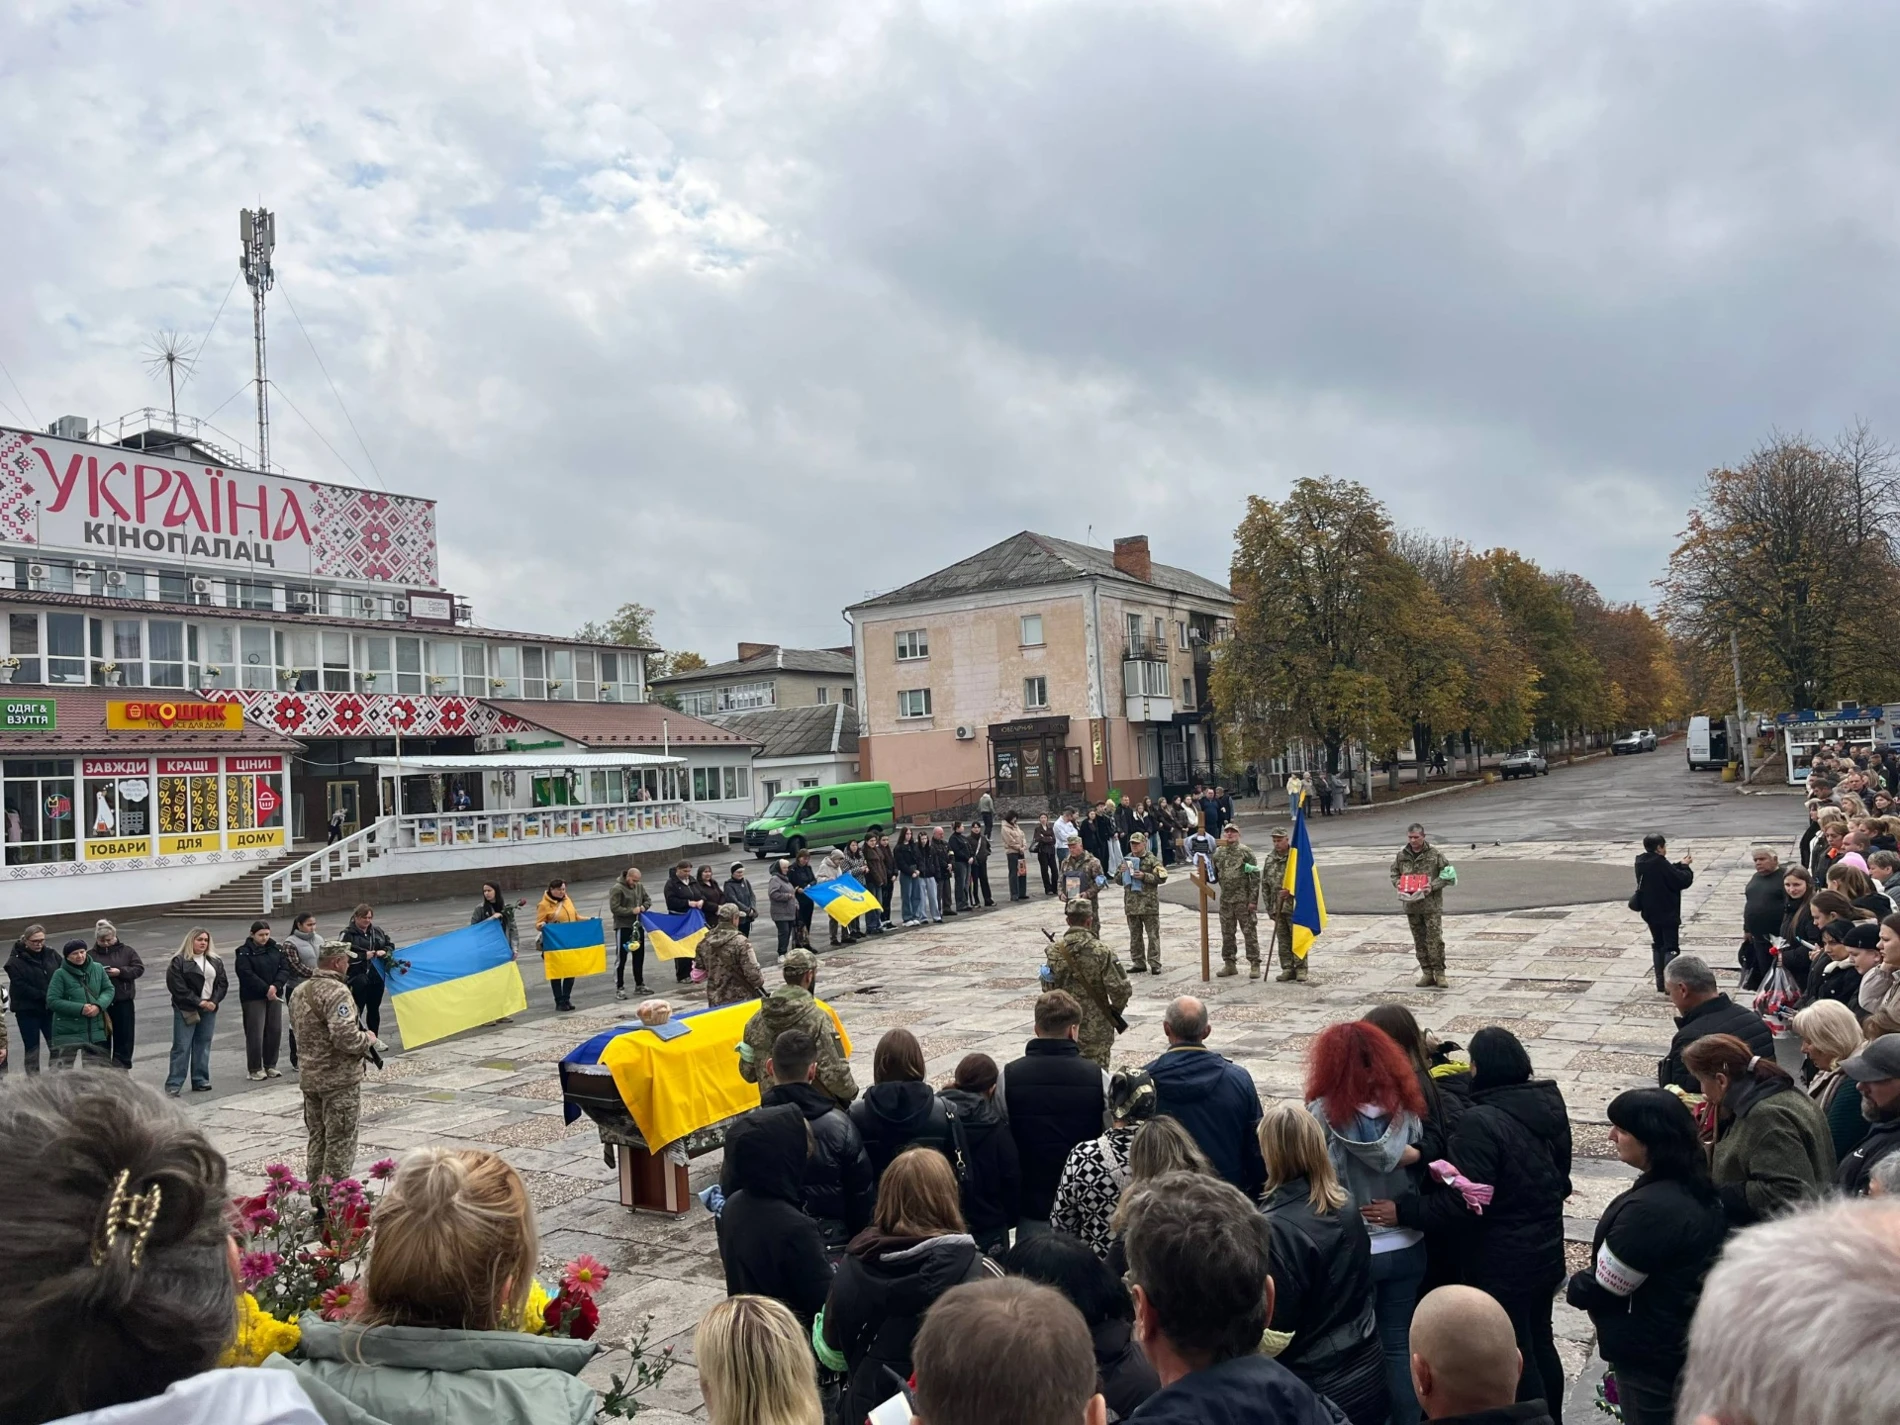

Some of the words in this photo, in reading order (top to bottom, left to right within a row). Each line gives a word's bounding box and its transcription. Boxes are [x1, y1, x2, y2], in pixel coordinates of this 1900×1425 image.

[31, 446, 312, 545] УКРАЇНА
[83, 521, 276, 568] КІНОПАЛАЦ
[7, 704, 38, 714] ОДЯГ
[40, 704, 47, 713] &
[145, 703, 227, 721] КОШИК
[7, 715, 48, 724] ВЗУТТЯ
[188, 721, 204, 729] ДЛЯ
[204, 721, 226, 729] ДОМУ
[85, 760, 148, 775] ЗАВЖДИ
[166, 760, 209, 772] КРАЩІ
[235, 758, 272, 771] ЦІНИ!
[90, 841, 146, 856] ТОВАРИ
[176, 838, 202, 851] ДЛЯ
[237, 833, 274, 846] ДОМУ
